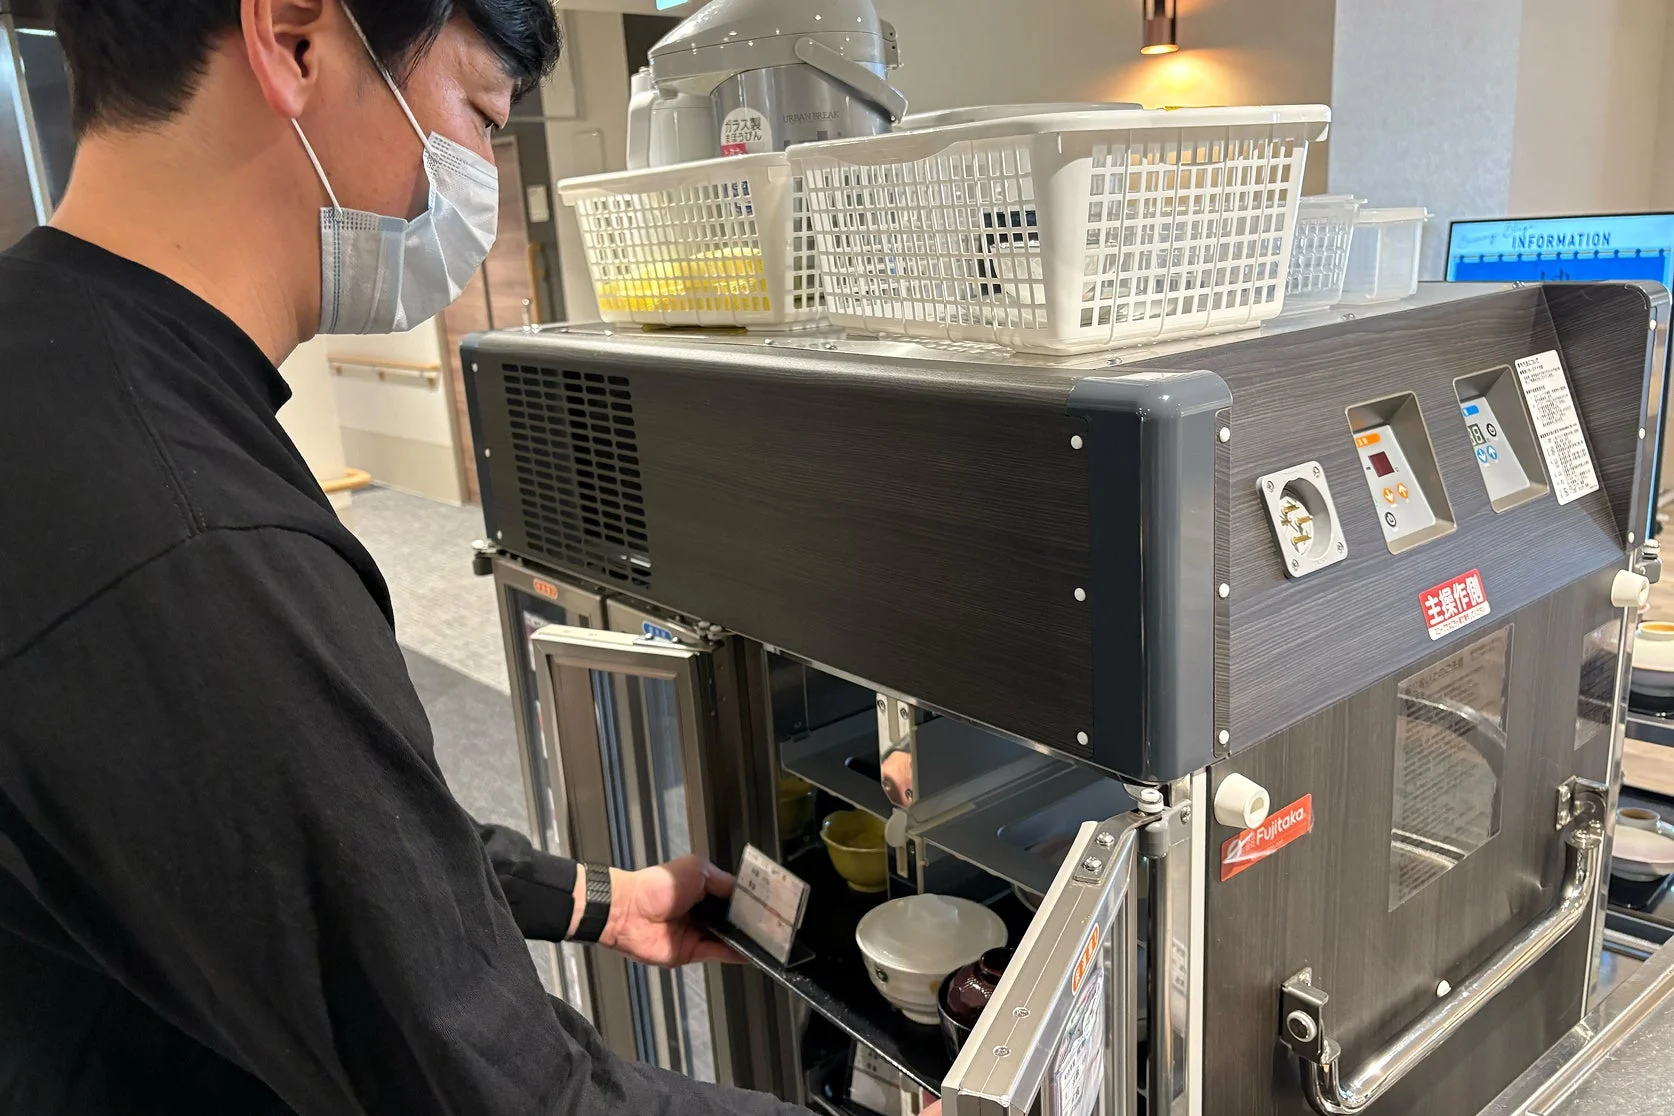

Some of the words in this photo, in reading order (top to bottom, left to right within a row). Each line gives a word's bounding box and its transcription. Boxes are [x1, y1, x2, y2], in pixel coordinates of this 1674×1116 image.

[783, 112, 811, 123] URBAN
[812, 110, 840, 121] BREAK
[724, 117, 762, 133] ガラス製
[725, 131, 762, 143] まほうびん
[1511, 232, 1611, 249] INFORMATION
[1424, 573, 1485, 626] 主操作側
[1256, 807, 1305, 845] Fujitaka
